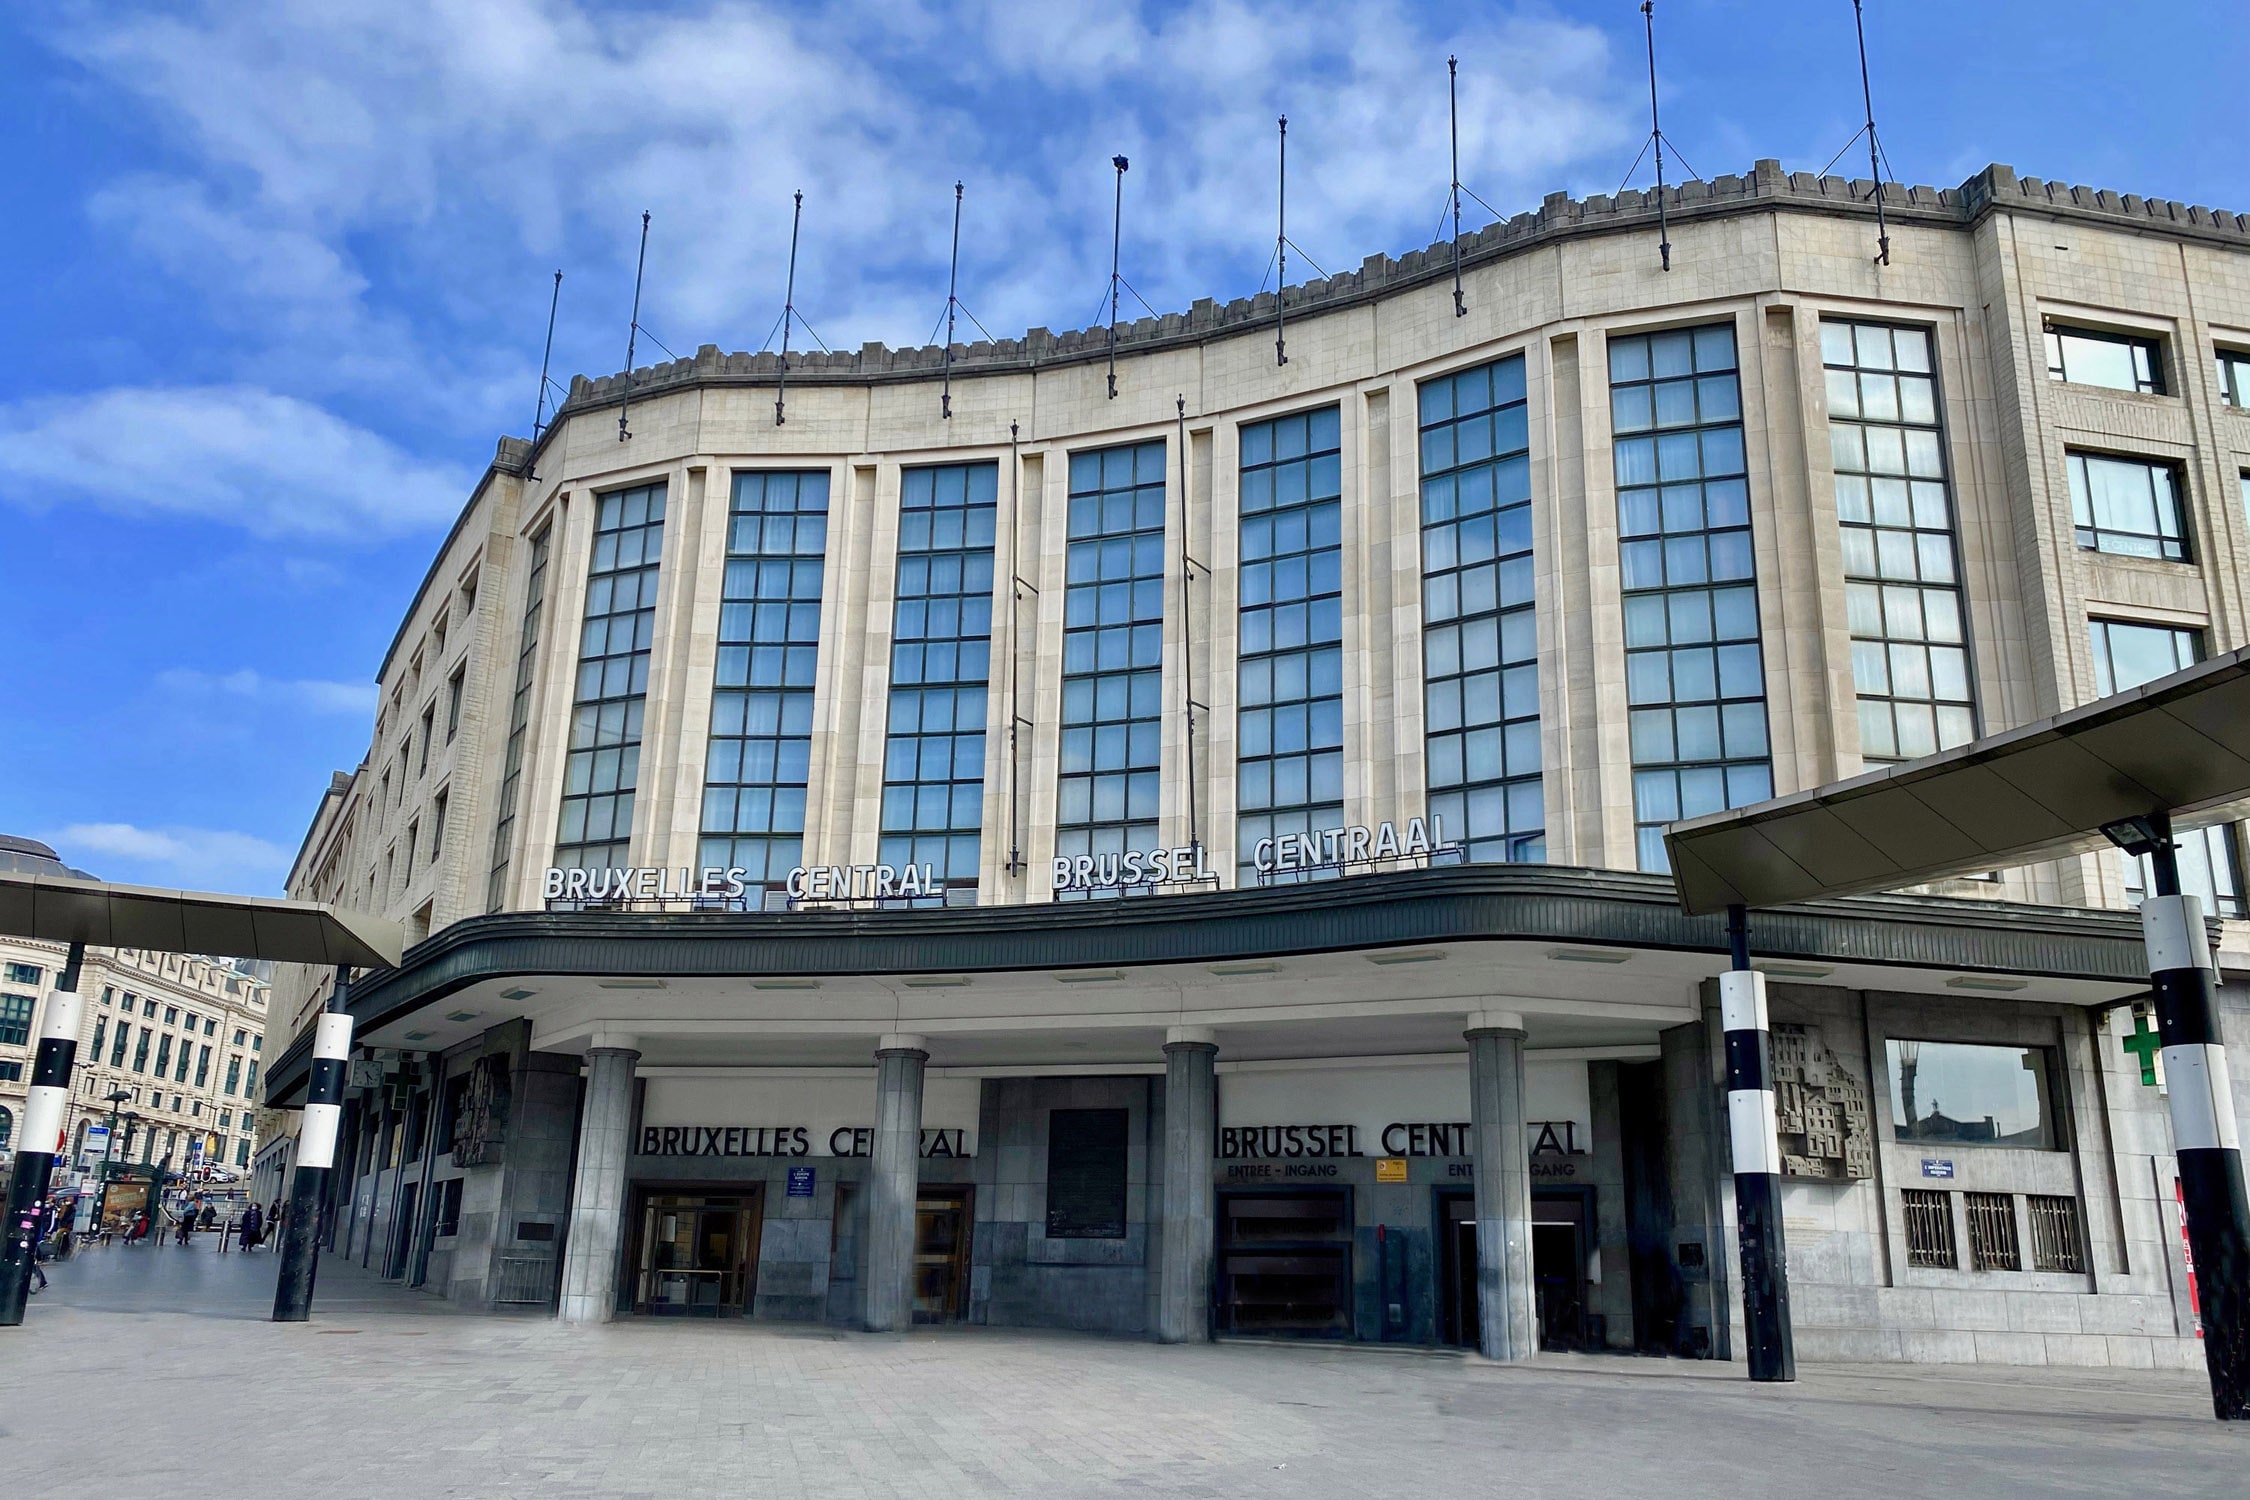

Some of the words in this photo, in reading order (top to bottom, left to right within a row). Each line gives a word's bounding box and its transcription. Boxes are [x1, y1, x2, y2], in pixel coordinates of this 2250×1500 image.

[1052, 846, 1216, 889] BRUSSEL
[1253, 814, 1457, 872] CENTRAAL
[543, 866, 748, 899] BRUXELLES
[786, 863, 944, 898] CENTRAL
[643, 1127, 808, 1157] BRUXELLES
[829, 1127, 971, 1158] CEAL
[1221, 1125, 1364, 1158] BRUSSEL
[1381, 1120, 1585, 1157] CENTAL
[1228, 1165, 1271, 1177] ENTREE
[1285, 1165, 1338, 1177] INGANG
